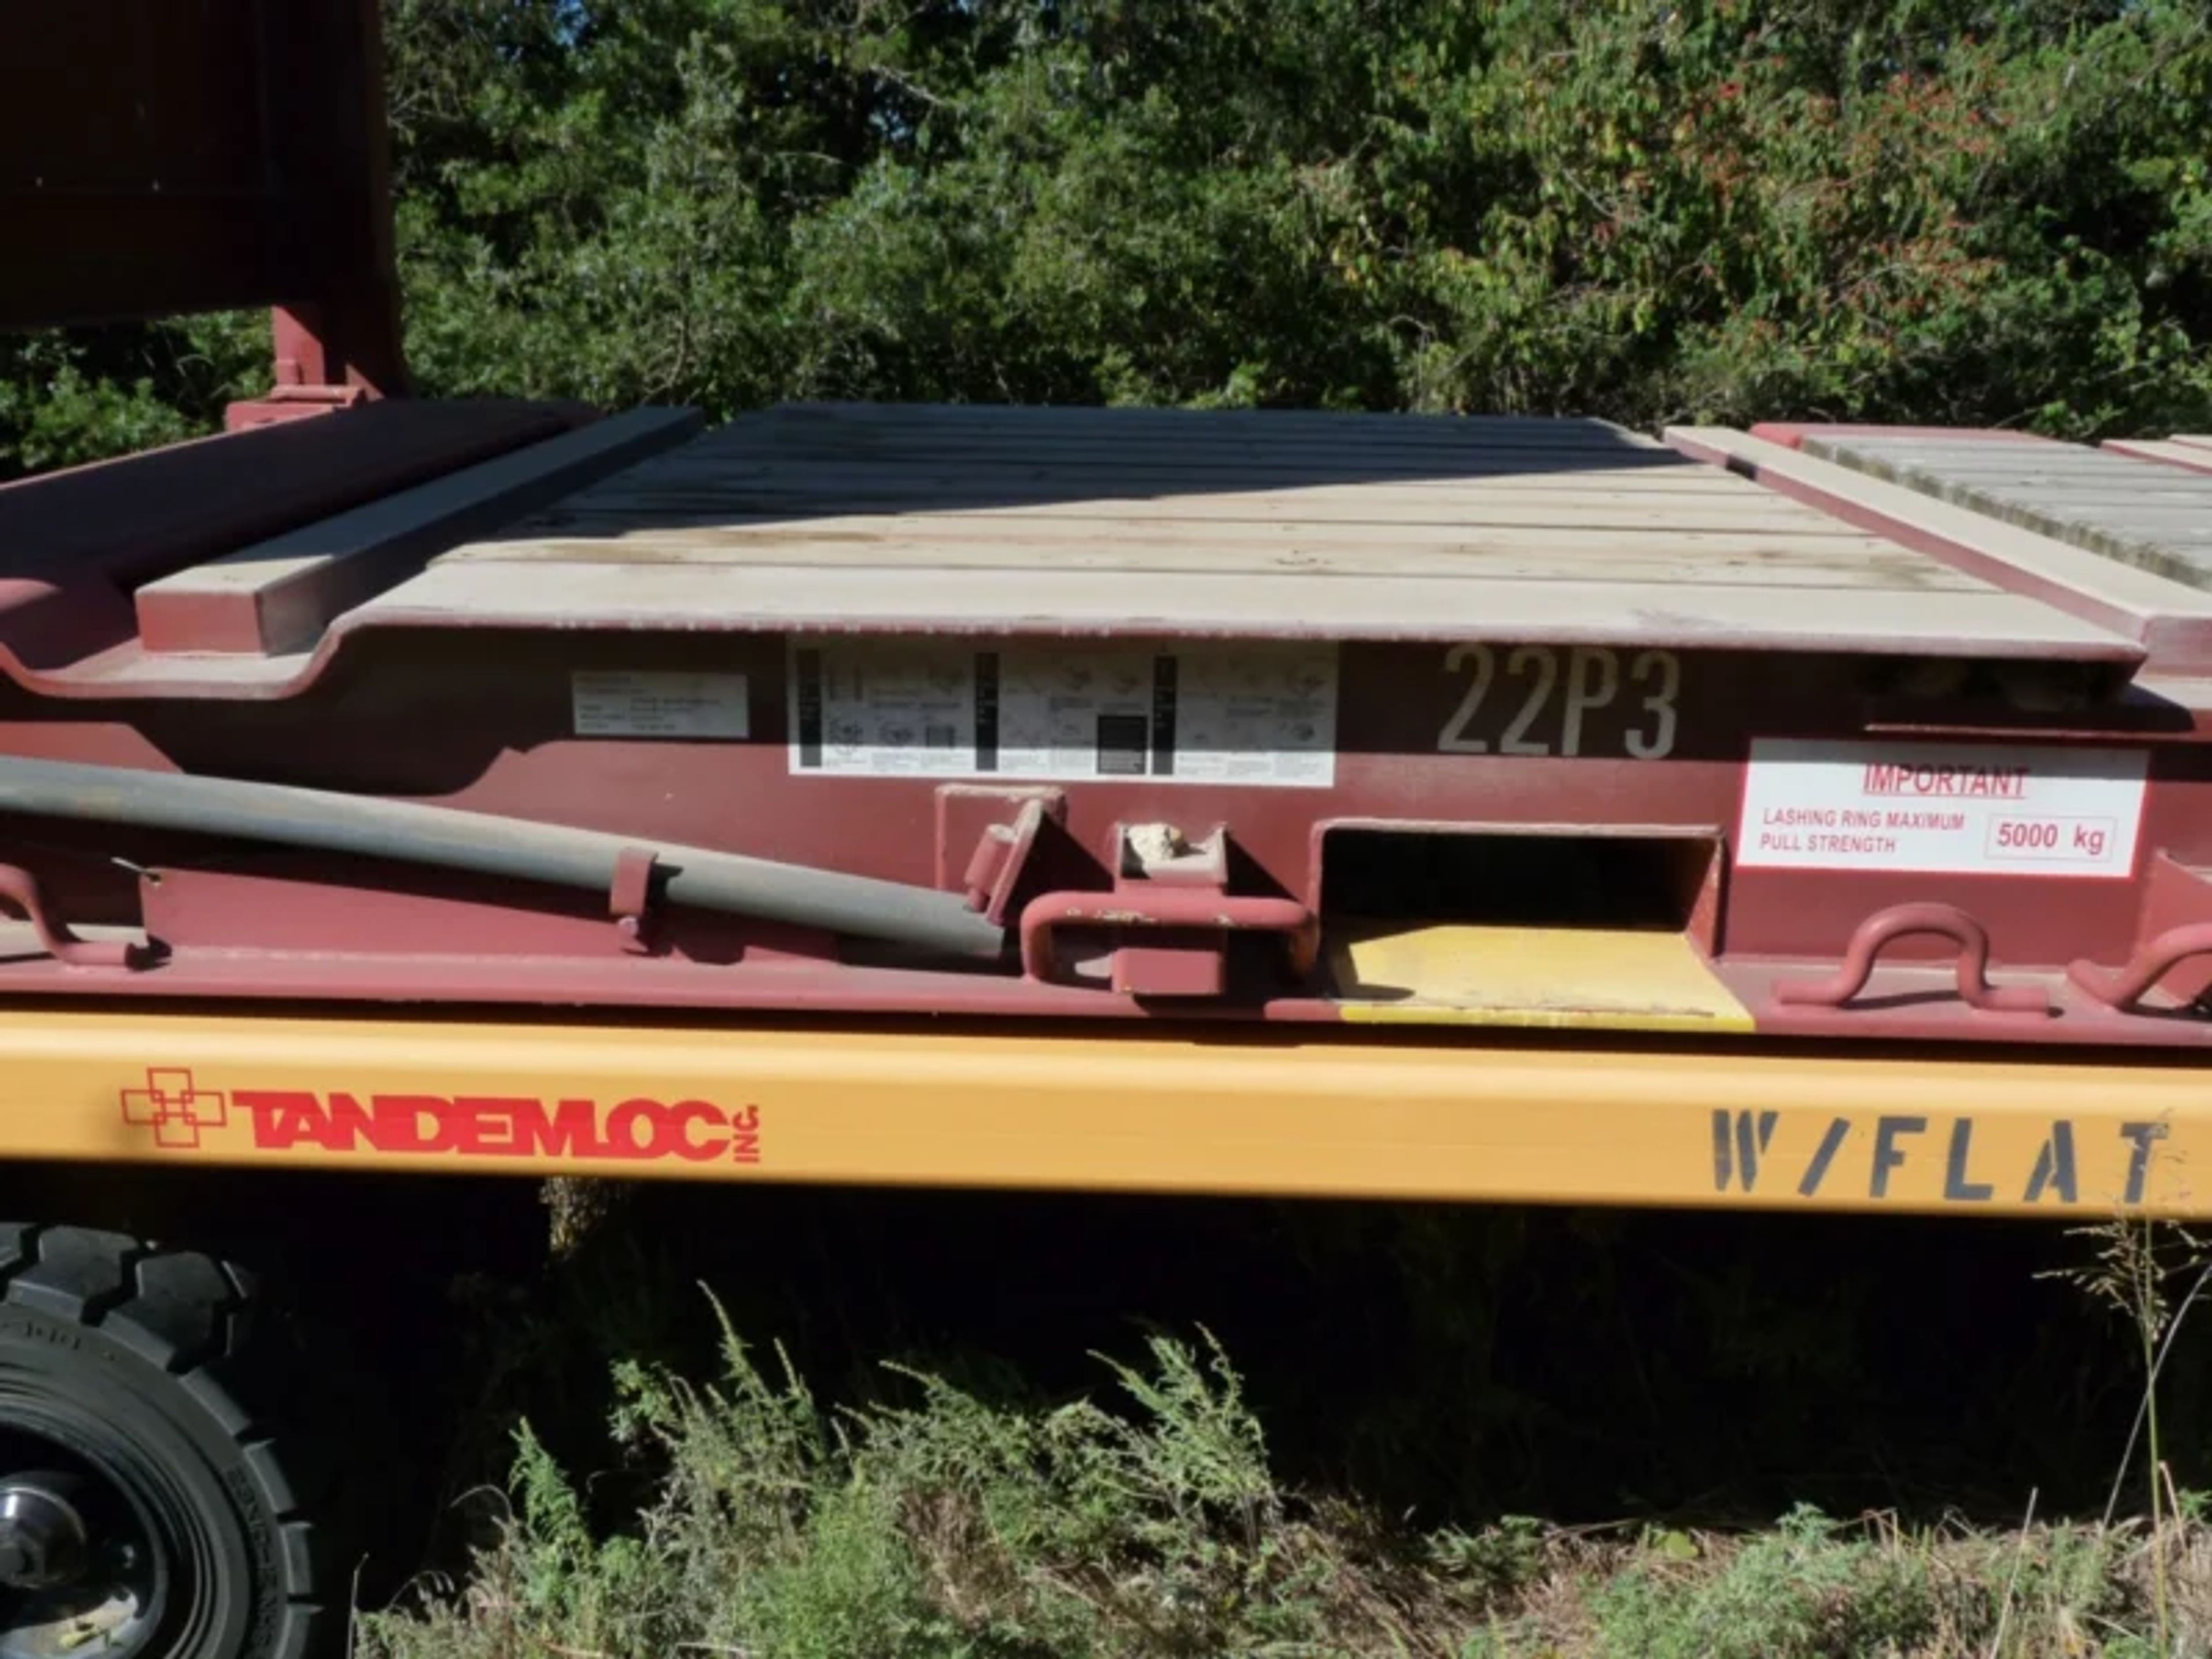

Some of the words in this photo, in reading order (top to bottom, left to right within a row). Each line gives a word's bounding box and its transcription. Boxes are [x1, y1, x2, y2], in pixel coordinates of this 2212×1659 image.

[1438, 643, 1680, 760] 22P3
[1863, 763, 2030, 796] IMPORTANT
[1763, 808, 1836, 828] LASHING
[1842, 810, 1882, 828] RING
[1886, 812, 1964, 831] MAXIMUM
[1760, 833, 1801, 851] PULL
[1808, 835, 1896, 853] STRENGTH
[1997, 823, 2059, 848] 5000
[2073, 825, 2105, 856] kg
[232, 1089, 731, 1162] TANDEMLOC
